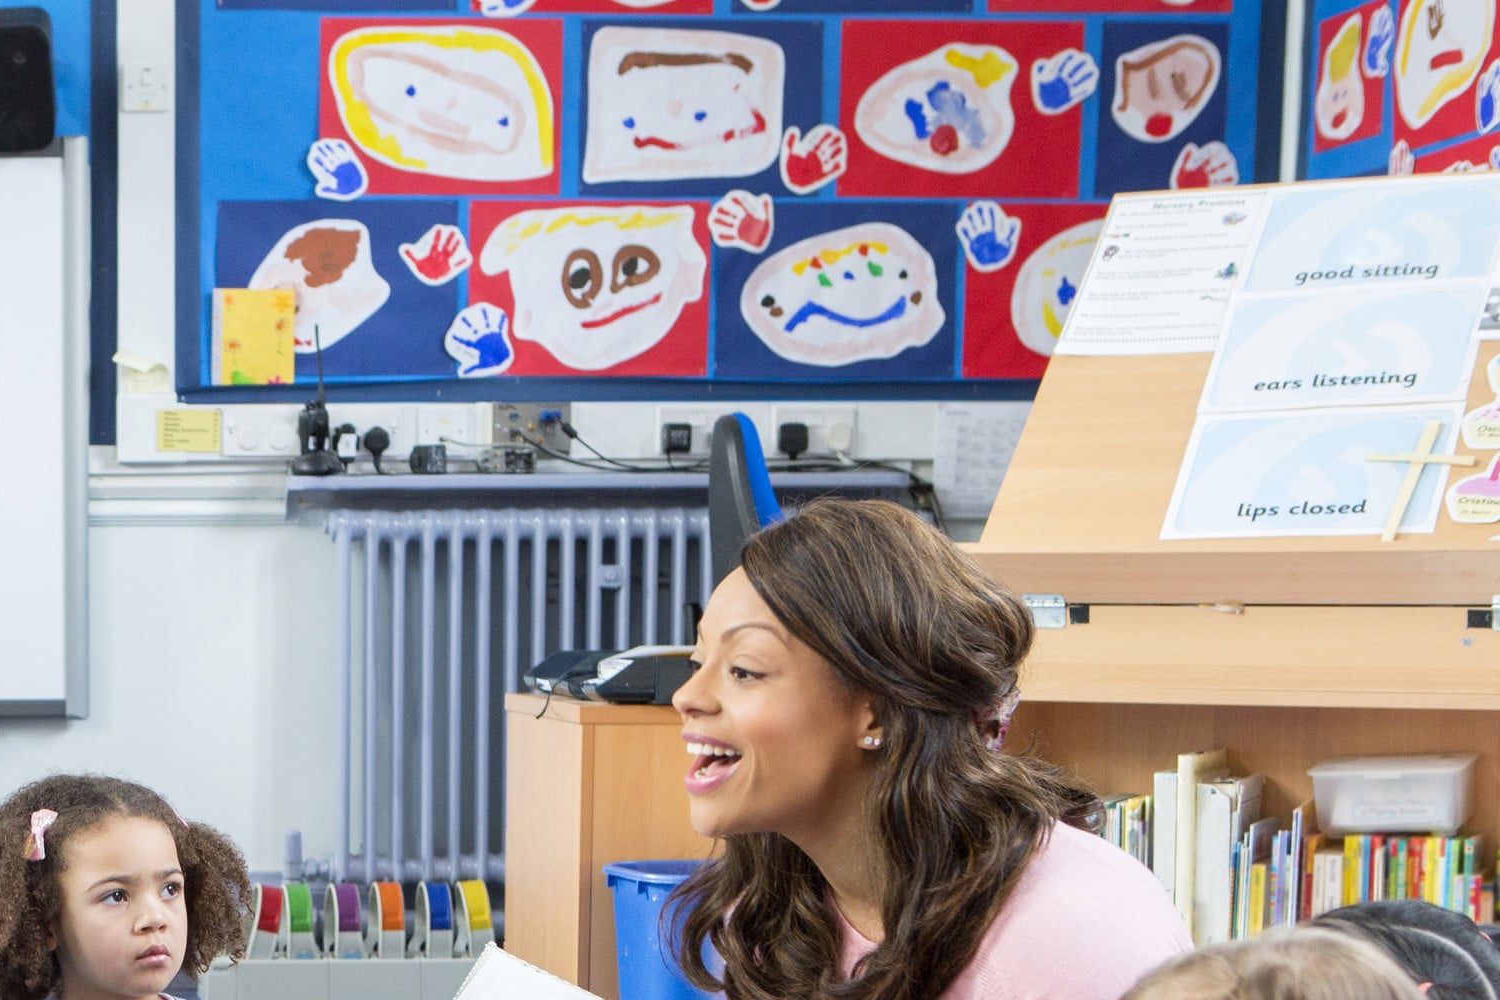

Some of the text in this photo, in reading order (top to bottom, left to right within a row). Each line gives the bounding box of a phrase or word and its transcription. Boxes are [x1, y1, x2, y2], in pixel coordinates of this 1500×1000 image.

[1295, 263, 1440, 286] good sitting
[1253, 371, 1418, 391] ears listening
[1237, 499, 1367, 522] lips closed
